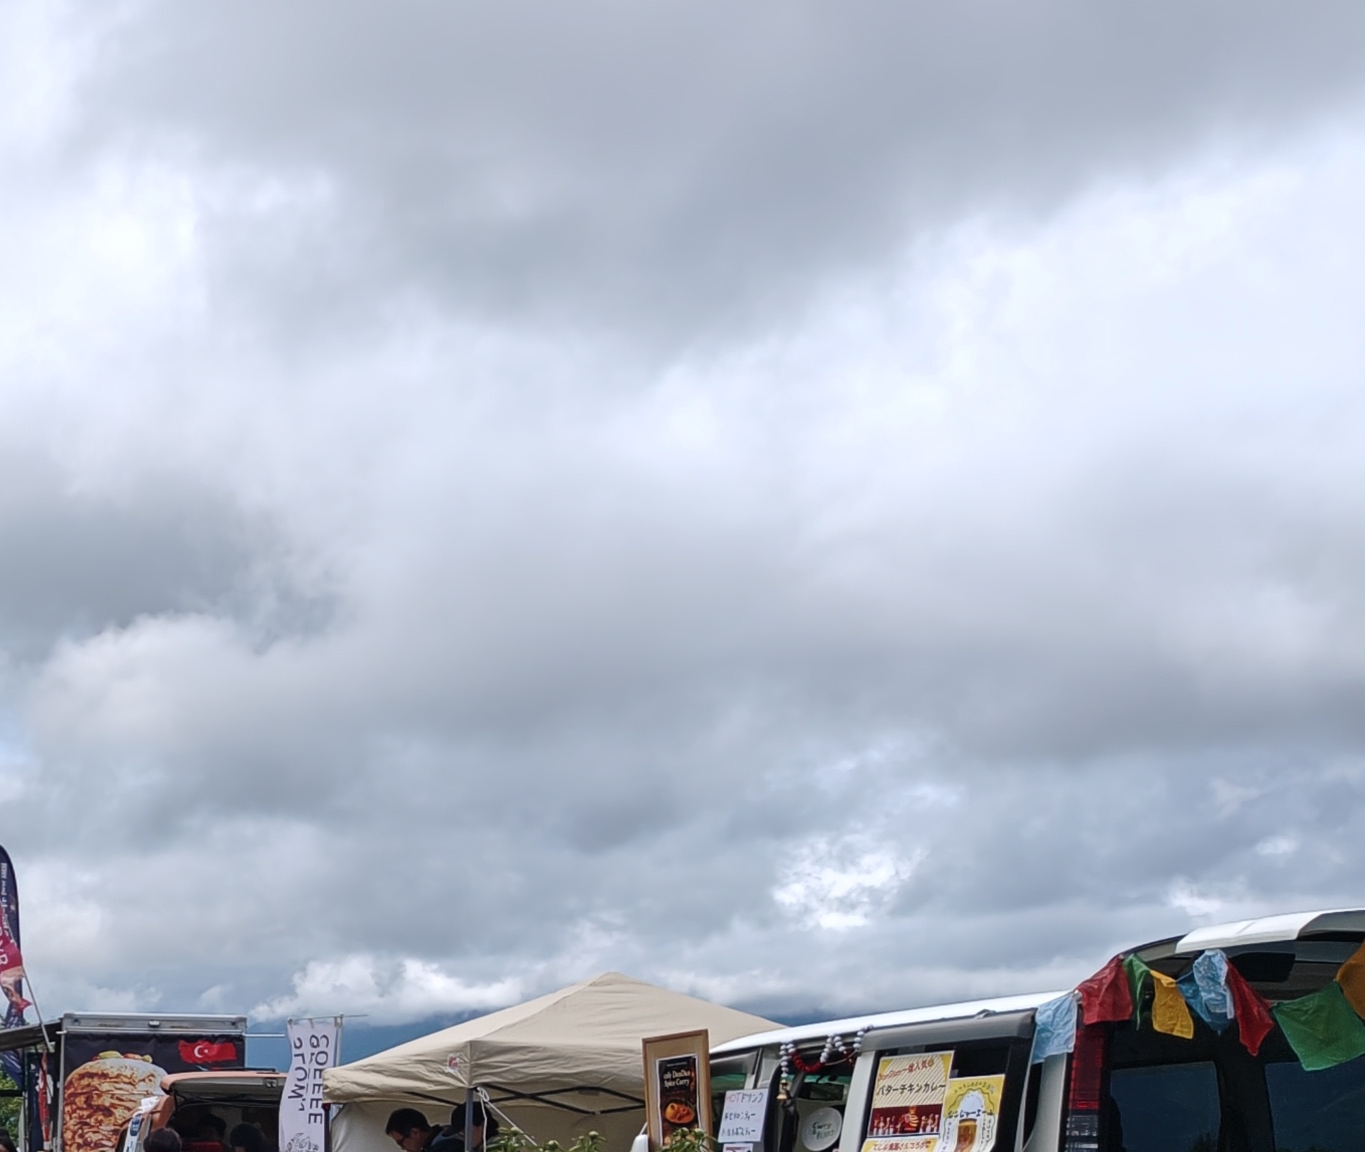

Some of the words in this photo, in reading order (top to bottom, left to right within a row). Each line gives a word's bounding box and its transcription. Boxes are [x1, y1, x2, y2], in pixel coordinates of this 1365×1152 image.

[877, 1082, 946, 1096] バターチキンカレー
